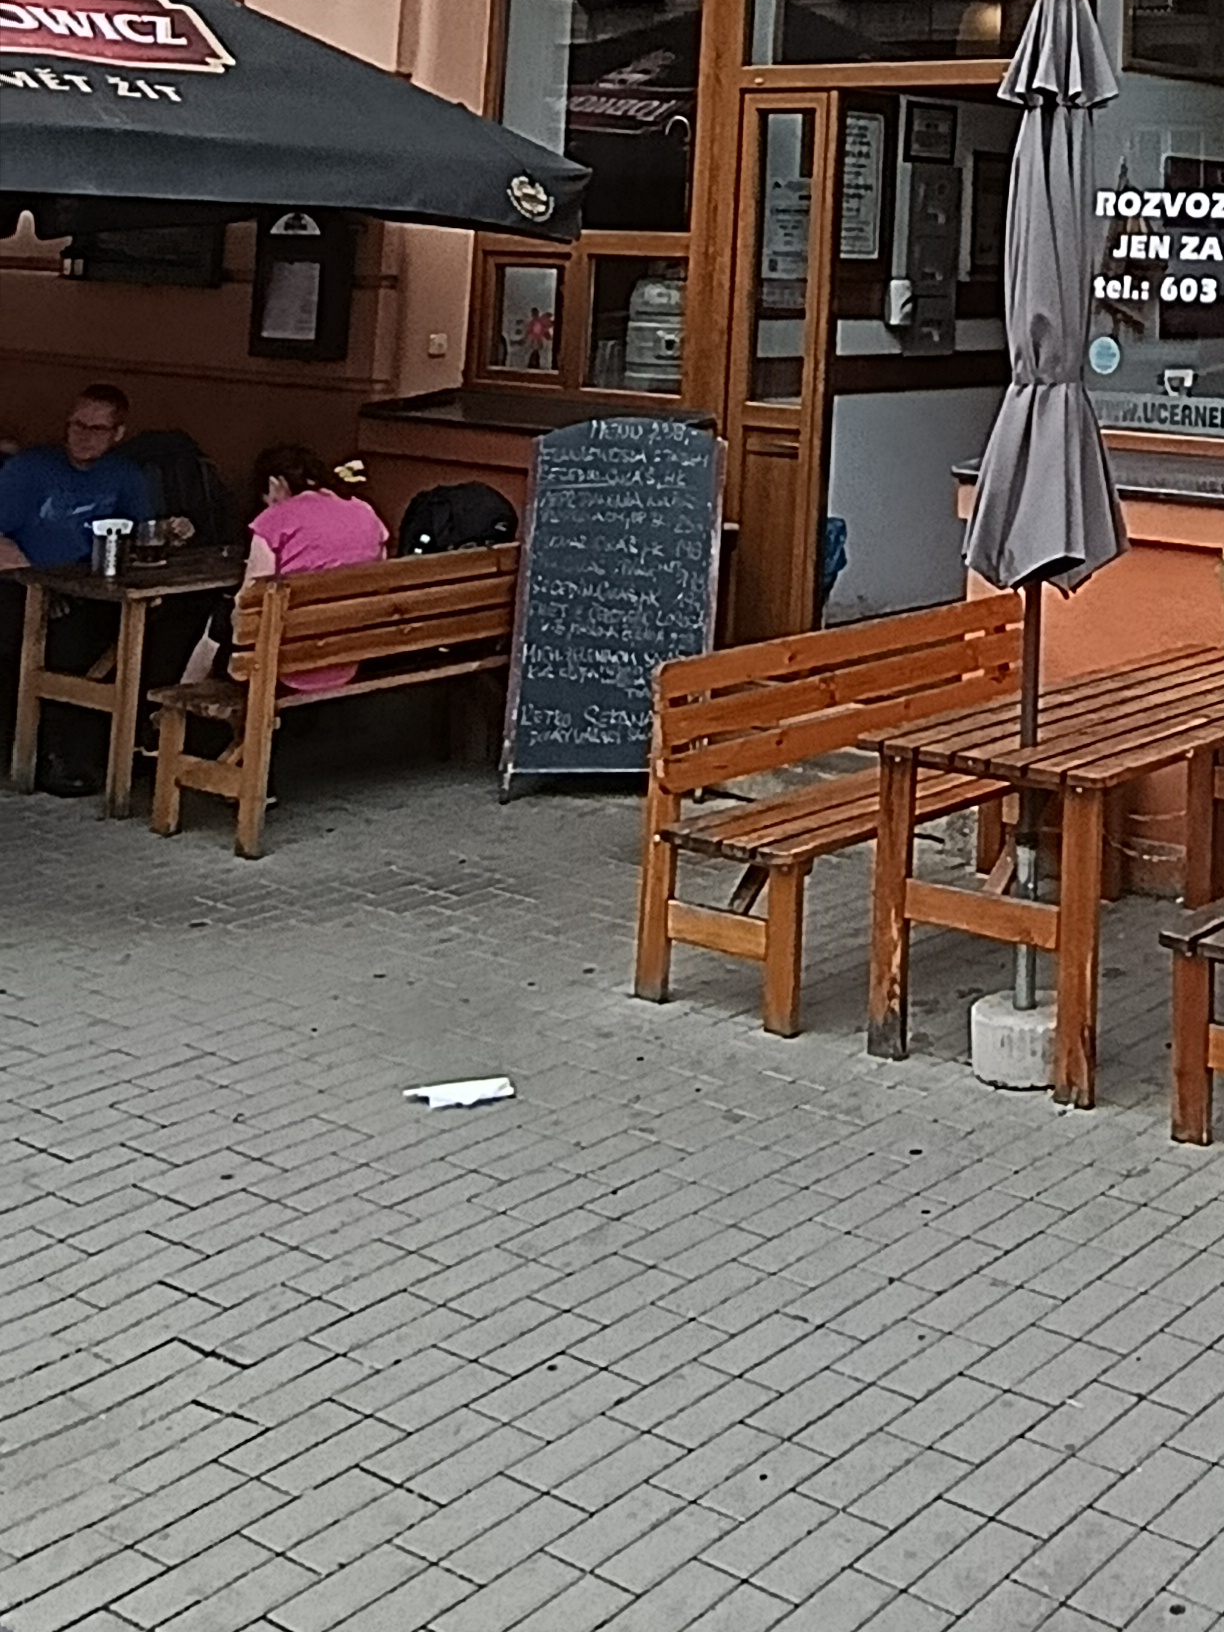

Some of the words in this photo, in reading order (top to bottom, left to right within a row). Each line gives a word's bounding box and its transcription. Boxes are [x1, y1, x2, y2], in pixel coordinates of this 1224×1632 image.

[1112, 234, 1171, 260] JEN
[1179, 235, 1224, 262] ZA
[1093, 274, 1150, 301] tel.:
[1159, 276, 1218, 303] 603
